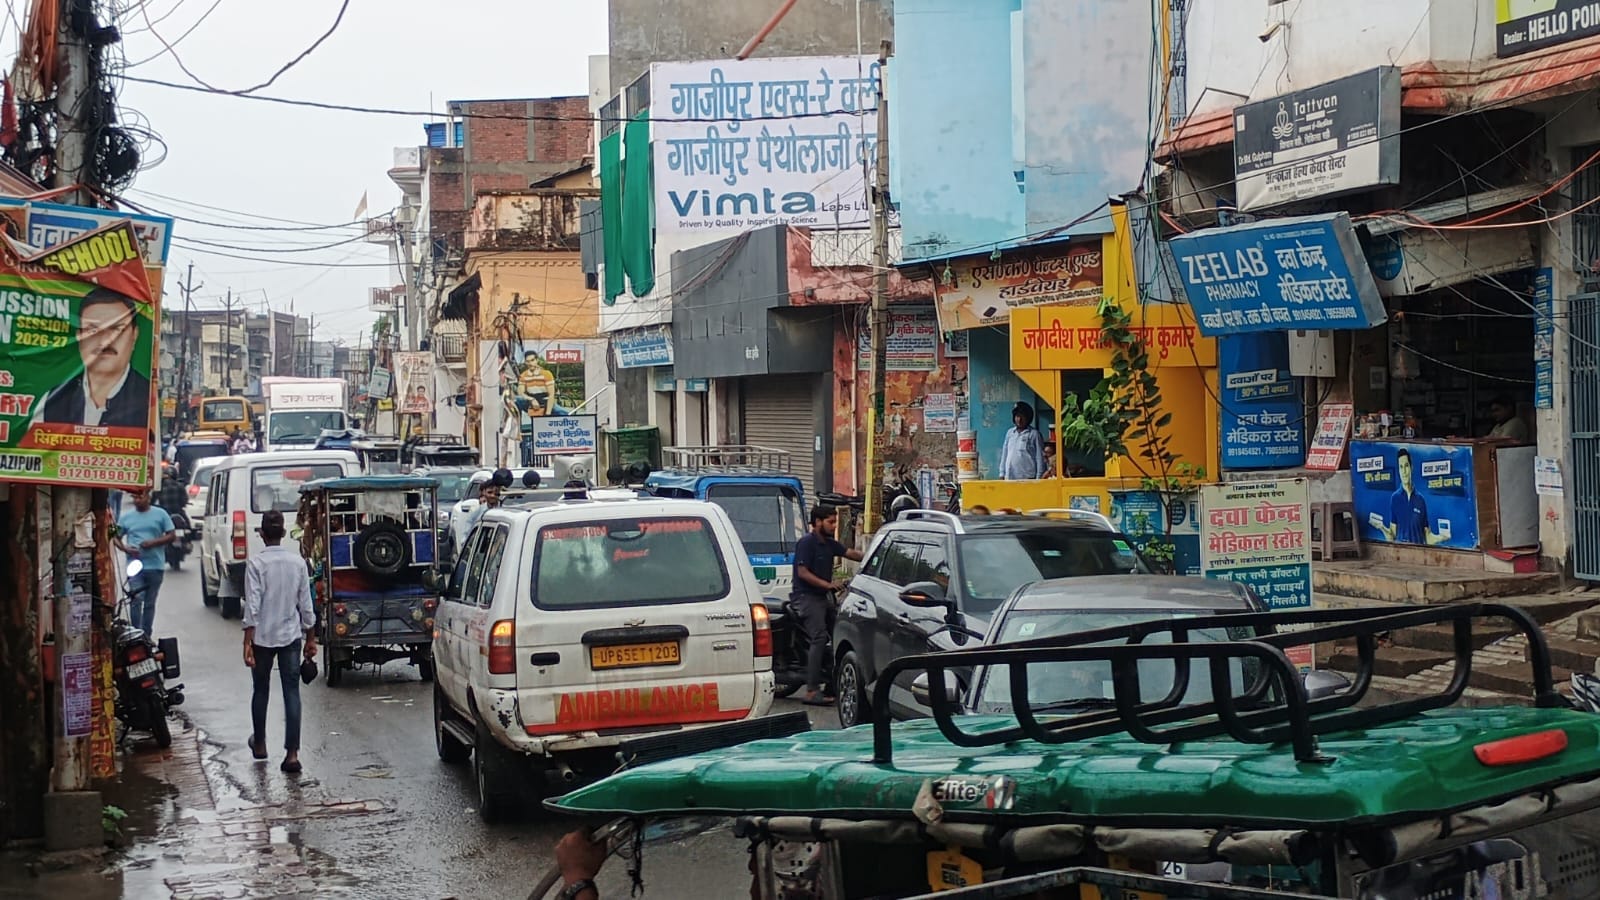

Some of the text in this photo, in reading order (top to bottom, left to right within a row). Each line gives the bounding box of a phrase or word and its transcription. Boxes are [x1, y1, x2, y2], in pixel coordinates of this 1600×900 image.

[1528, 11, 1568, 42] HELLO
[670, 68, 753, 132] गाजीपुर
[839, 62, 880, 112] क्ली
[1293, 95, 1338, 116] Tattvan
[666, 125, 751, 186] गाजीपुर
[667, 188, 817, 217] Vimta
[821, 201, 851, 212] Labs
[716, 217, 744, 229] Quality
[791, 215, 818, 226] Science
[44, 229, 137, 275] SCHOOL
[1275, 248, 1300, 270] दवा
[1182, 247, 1270, 285] ZEELAB
[1205, 281, 1261, 302] PHARMACY
[1277, 270, 1352, 304] मेडिकल स्टोर
[16, 316, 70, 333] SESSION
[15, 332, 68, 348] 2026-27
[1022, 319, 1075, 350] जगदीश
[1156, 326, 1196, 360] कुमार
[1230, 373, 1261, 385] दवाओं
[1237, 409, 1289, 426] दवा केन्द्र
[89, 435, 143, 452] कुशवाहा
[1227, 427, 1273, 445] मेडिकल
[1273, 426, 1300, 442] स्टोर
[59, 454, 141, 469] 9115222349
[58, 467, 139, 482] 9120189817
[1209, 501, 1302, 528] दवा केन्द्र
[1209, 527, 1304, 553] मेडिकल स्टोर
[1234, 572, 1247, 581] पर
[1250, 569, 1268, 580] सभी
[1272, 593, 1307, 606] मिलती है
[600, 643, 680, 664] UP65ET1203
[557, 683, 719, 724] AMBULANCE
